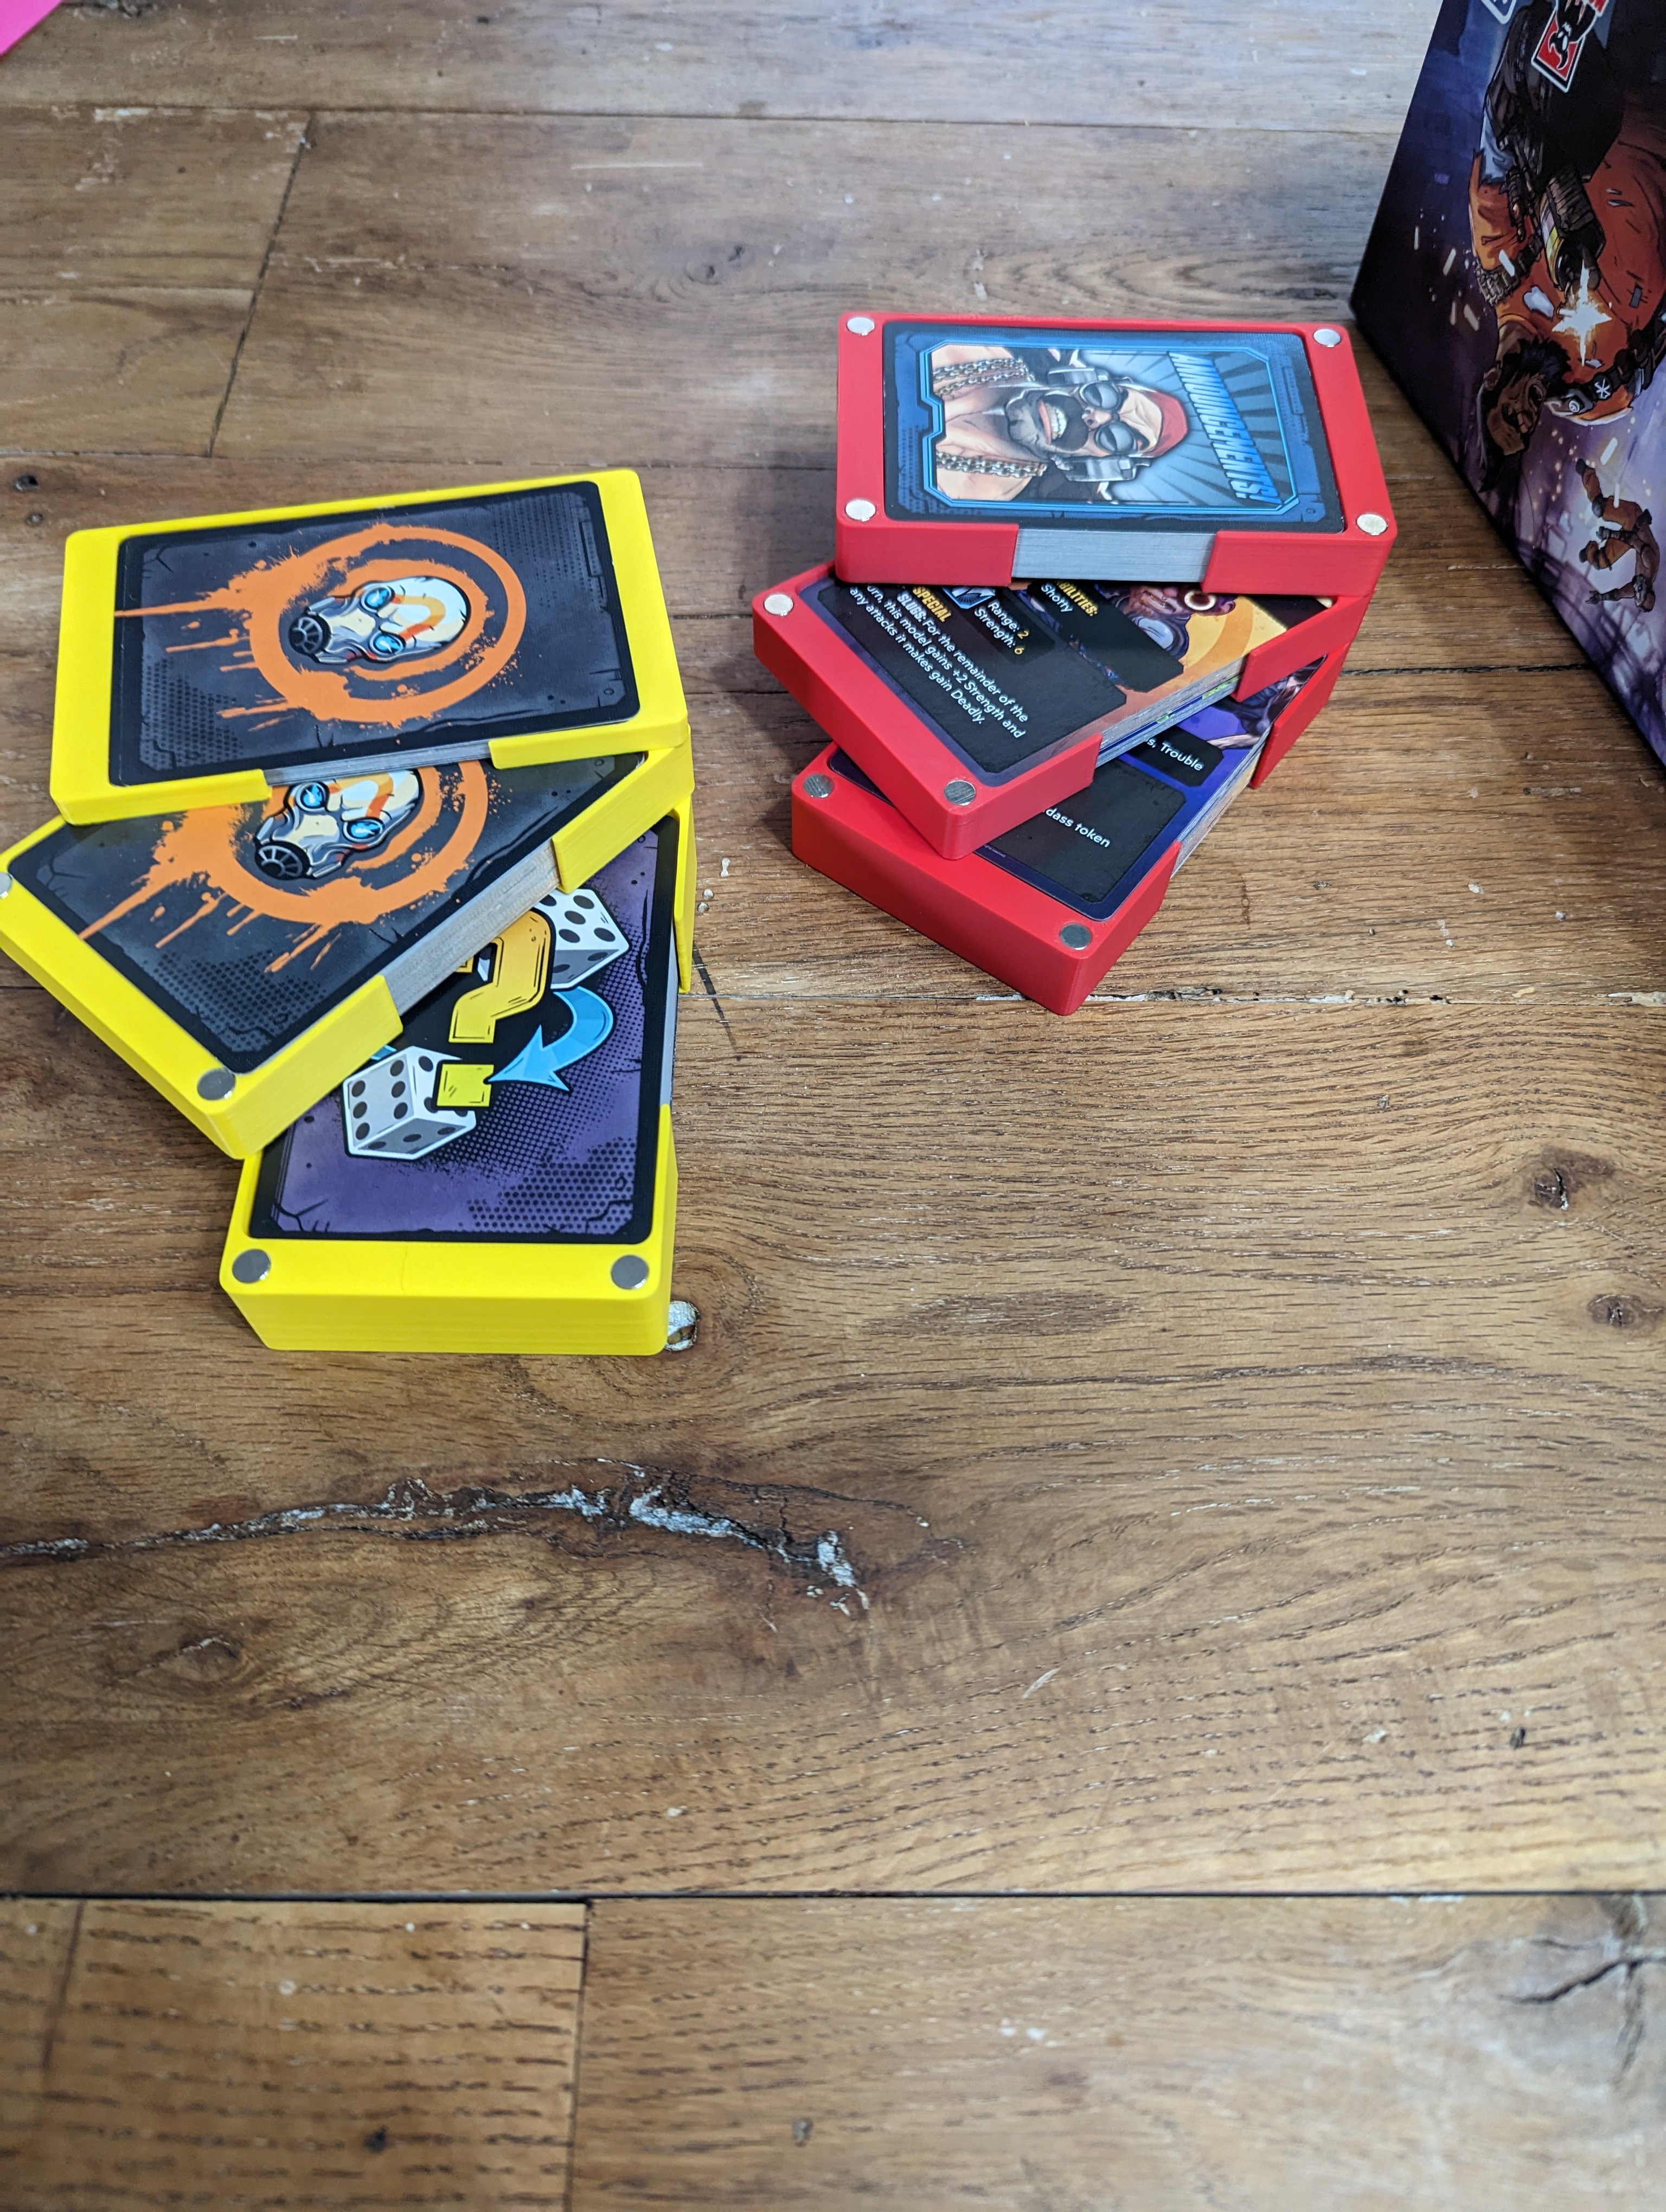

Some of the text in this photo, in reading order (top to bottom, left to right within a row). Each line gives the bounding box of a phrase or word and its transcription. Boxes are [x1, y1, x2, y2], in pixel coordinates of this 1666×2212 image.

[1168, 351, 1283, 505] ANNOUNCEMENTS!
[913, 587, 952, 622] SPECIAL
[988, 599, 1029, 639] Range: 2
[1041, 582, 1073, 613] Shotty
[975, 606, 1025, 655] Strength: 6
[850, 586, 985, 724] any attacks it makes gain Deadly.
[867, 586, 1027, 738] urn, this model gains +2 Strength and
[897, 590, 1029, 723] SLUGS: For the remainder of the
[1160, 740, 1205, 771] Trouble
[1074, 823, 1111, 848] token
